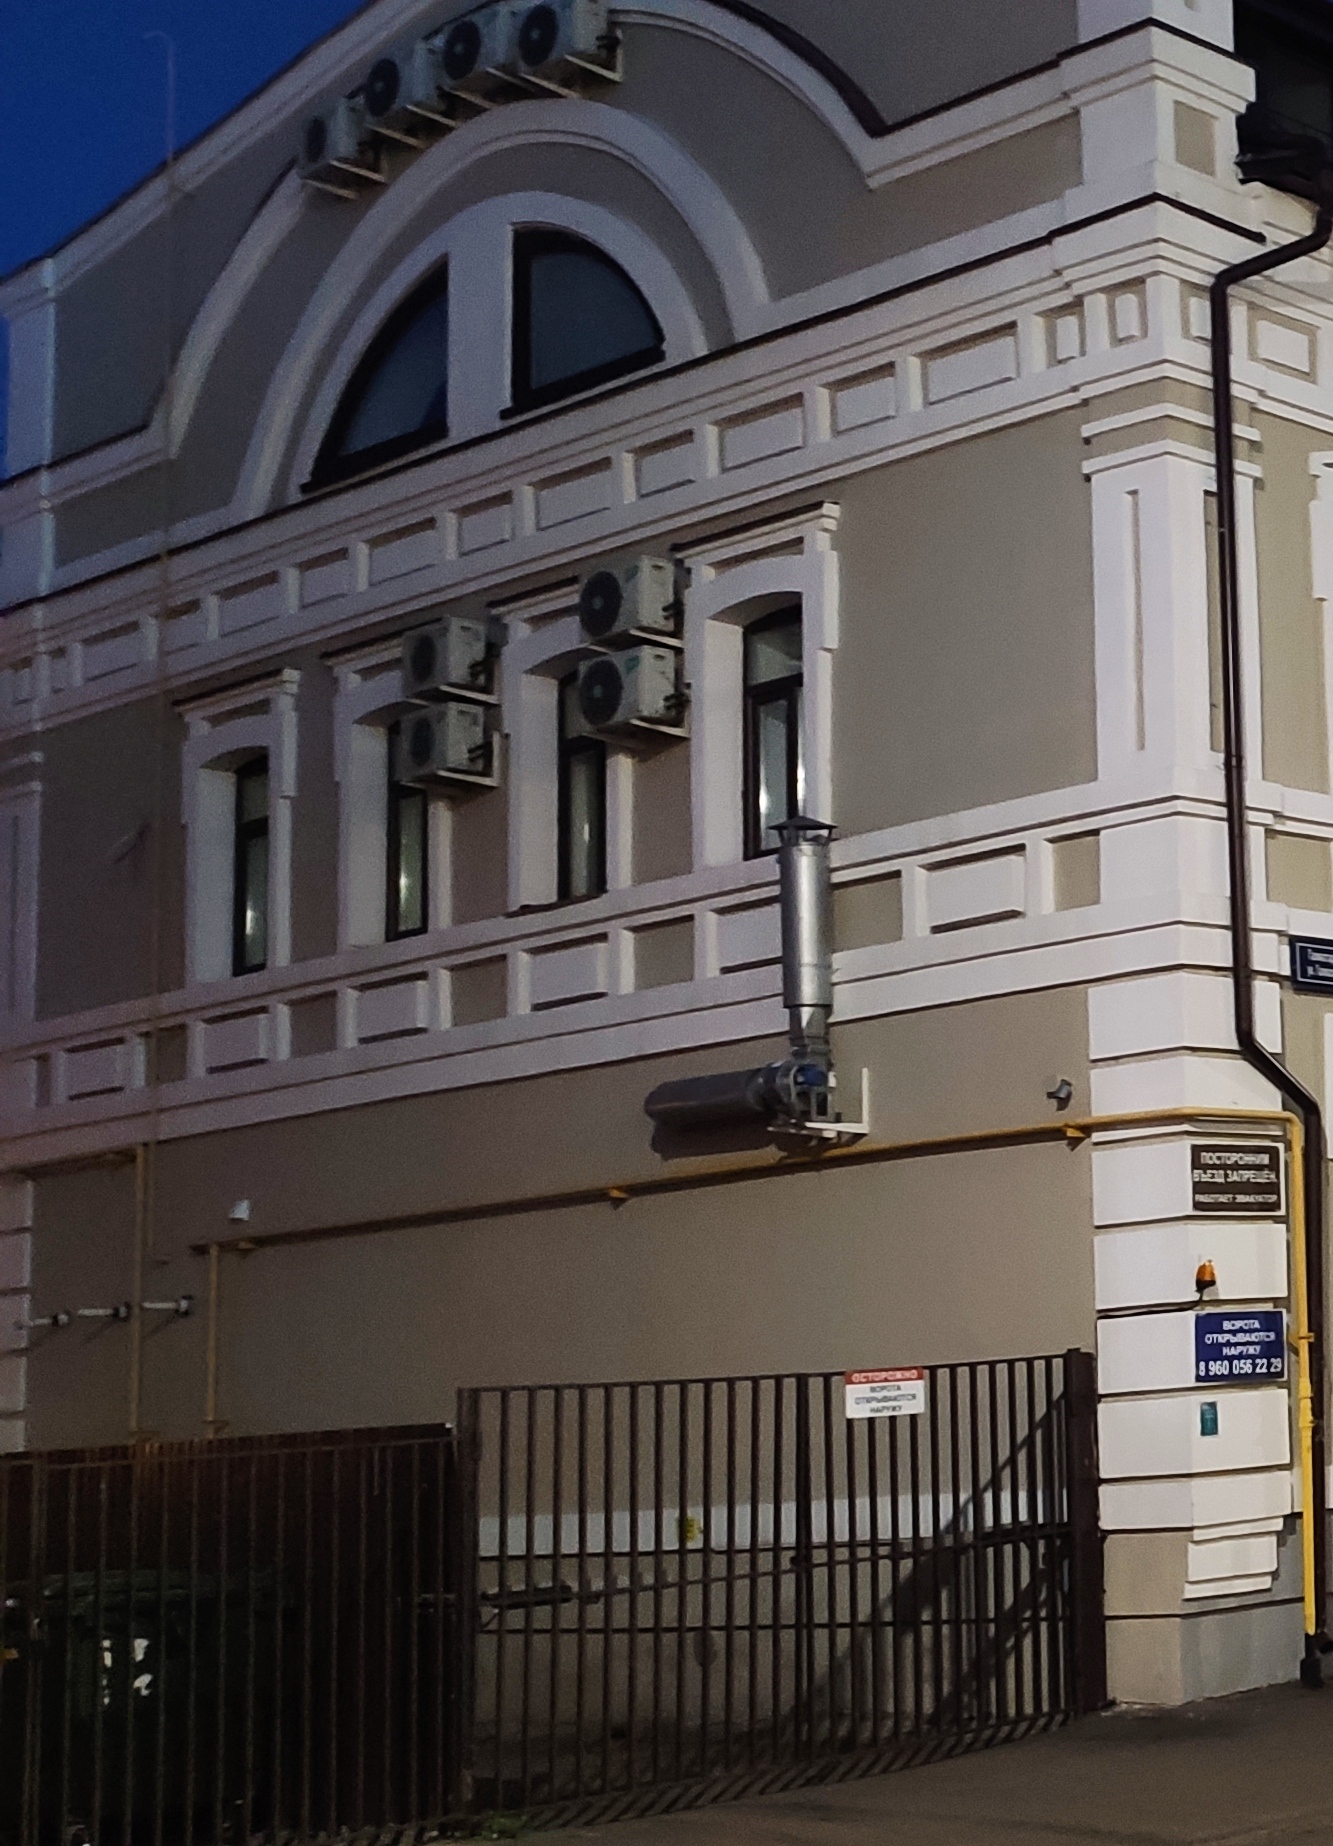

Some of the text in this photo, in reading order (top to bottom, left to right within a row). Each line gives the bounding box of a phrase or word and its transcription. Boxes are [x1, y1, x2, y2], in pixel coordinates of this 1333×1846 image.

[1222, 1320, 1261, 1330] ВОРОТА
[1204, 1331, 1276, 1344] ОТКРЫВАЮТСЯ
[1222, 1345, 1261, 1356] НАРУЖУ
[1198, 1357, 1282, 1377] 8 960 056 22 29
